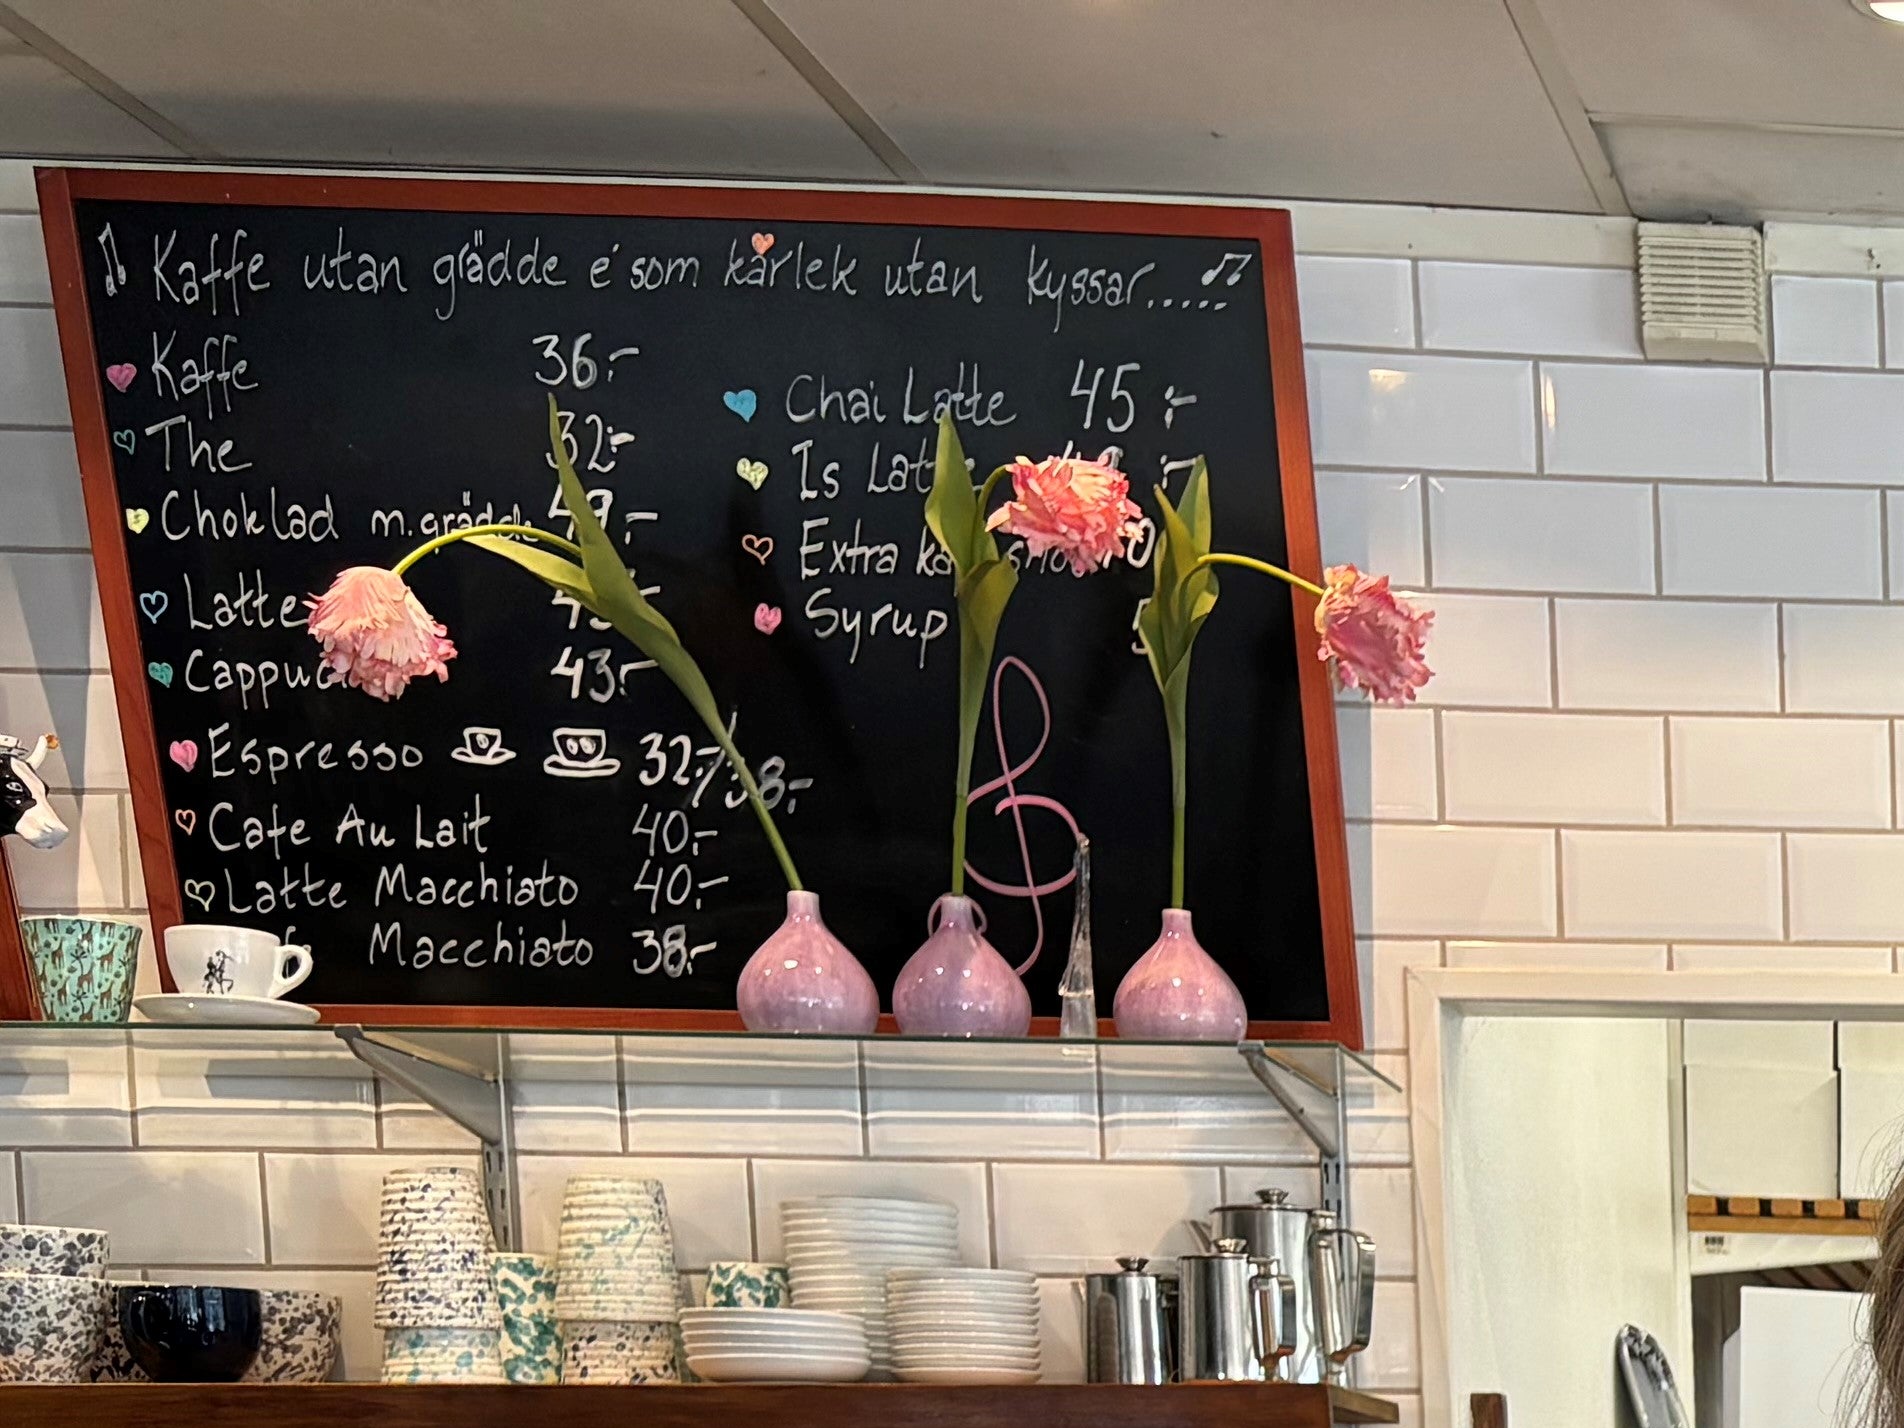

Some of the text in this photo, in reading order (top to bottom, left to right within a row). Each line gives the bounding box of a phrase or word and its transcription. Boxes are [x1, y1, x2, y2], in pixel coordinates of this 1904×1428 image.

[155, 229, 270, 316] Kaffe
[304, 228, 407, 293] utan
[433, 230, 566, 320] grädde
[631, 255, 699, 291] som
[886, 238, 983, 303] utan
[152, 330, 258, 420] Kaffe
[786, 372, 888, 424] Chai
[903, 361, 1017, 426] Latte
[145, 415, 252, 473] The
[792, 441, 840, 500] Is
[162, 491, 339, 542] Choklad
[800, 517, 899, 579] Extra
[185, 570, 308, 628] Latte
[805, 589, 948, 669] Syrup
[209, 724, 423, 779] Espresso
[209, 803, 311, 860] Cafe
[336, 804, 395, 848] Au
[416, 794, 491, 854] Lait
[225, 864, 346, 914] Latte
[375, 863, 579, 910] Macchiato
[369, 922, 593, 970] Macchiato
